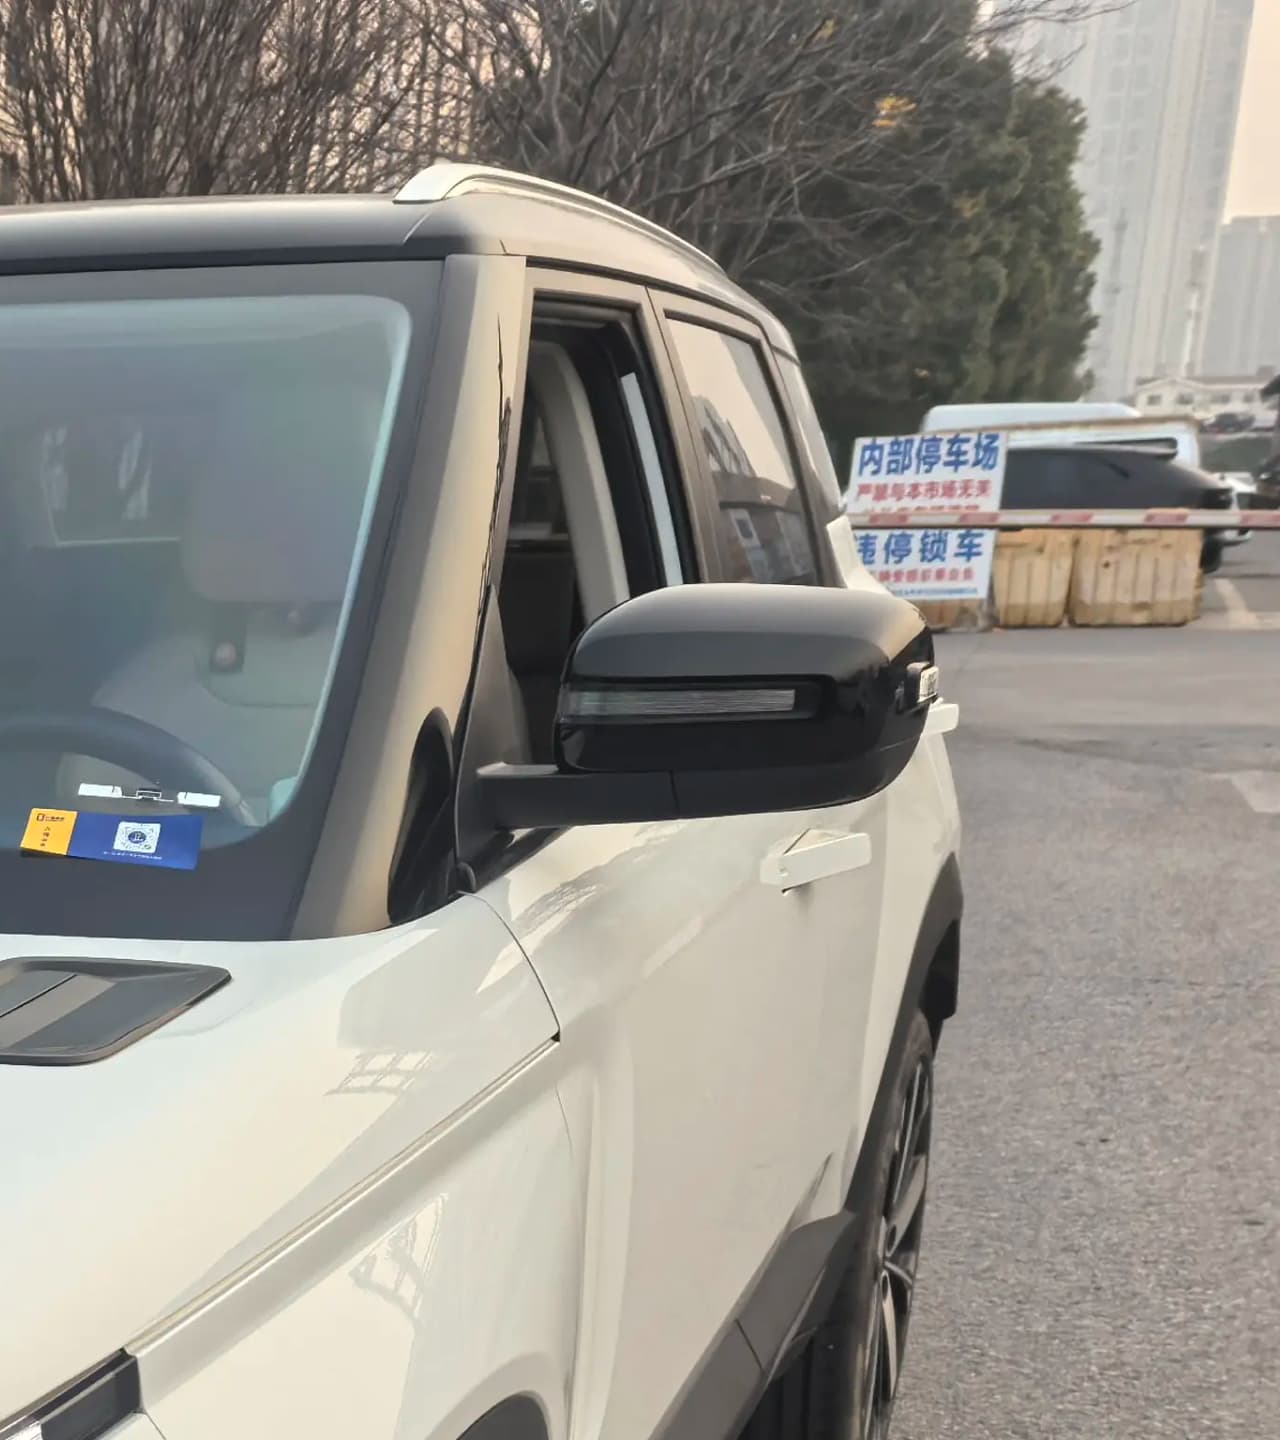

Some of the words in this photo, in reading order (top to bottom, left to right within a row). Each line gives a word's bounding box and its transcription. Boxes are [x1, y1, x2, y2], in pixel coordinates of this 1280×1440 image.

[859, 432, 1000, 475] 内部停车场
